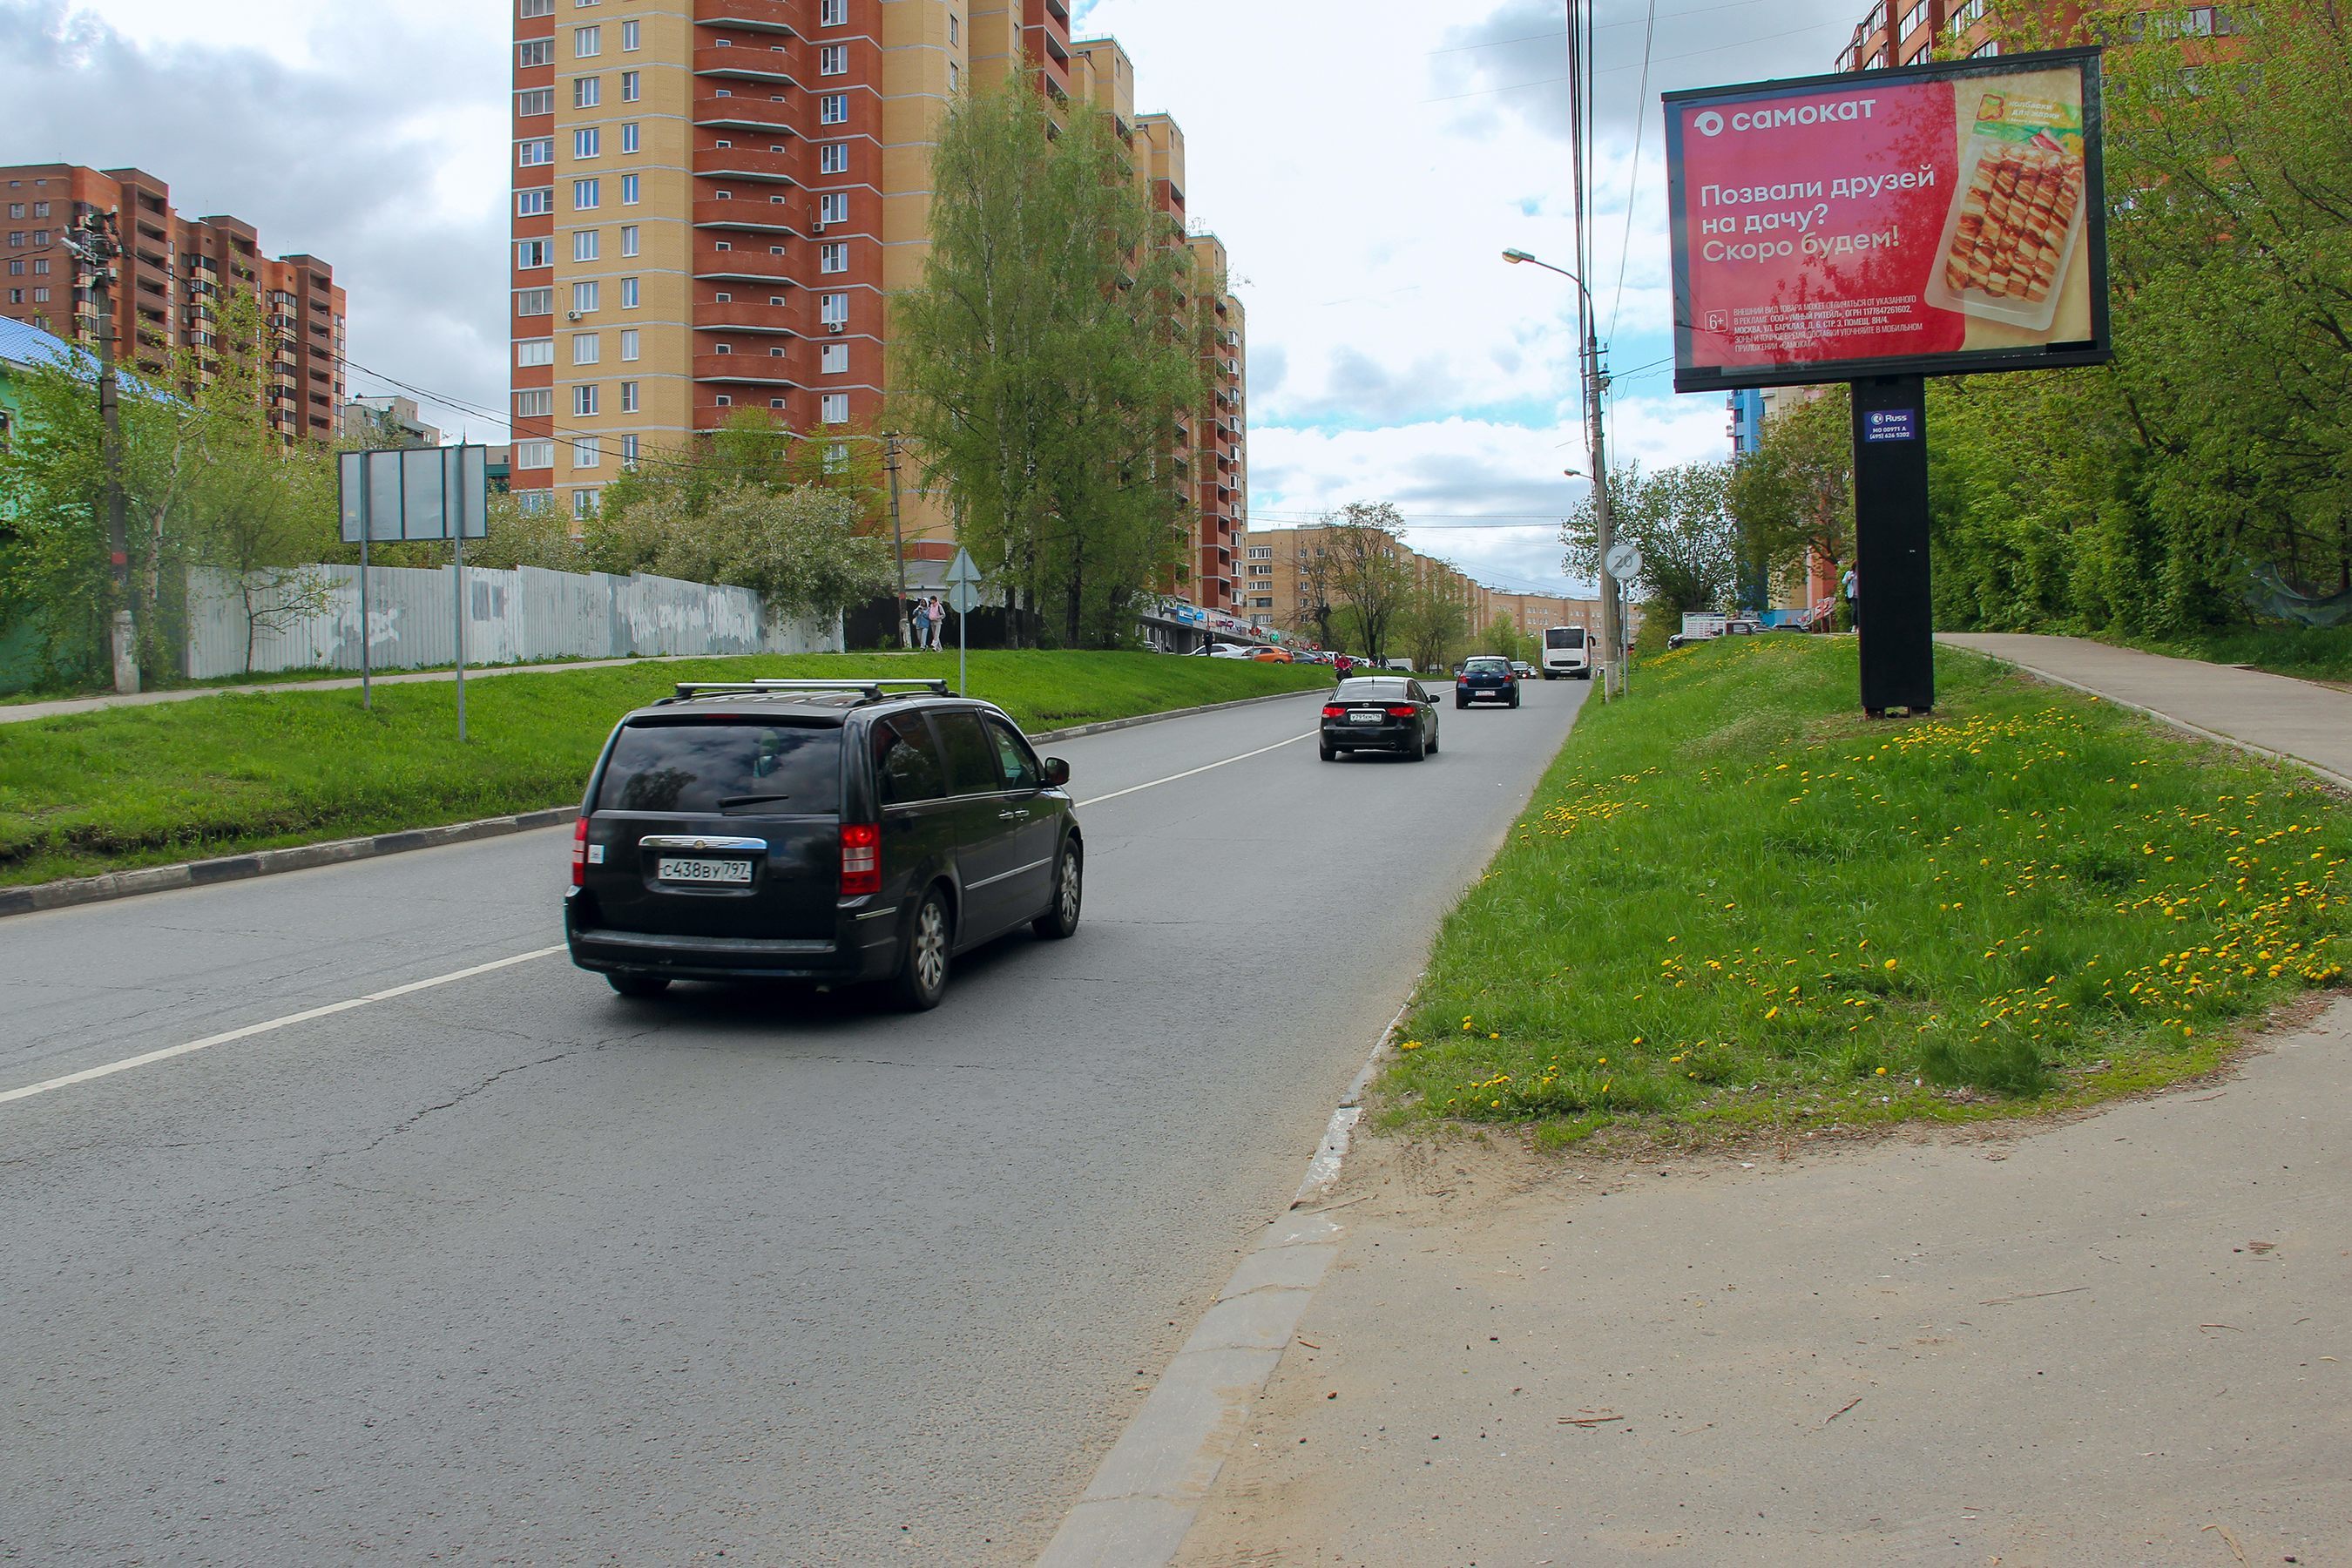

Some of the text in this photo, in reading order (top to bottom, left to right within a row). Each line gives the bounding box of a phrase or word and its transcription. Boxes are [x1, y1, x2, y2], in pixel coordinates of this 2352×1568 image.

[1732, 99, 1876, 131] самокат
[1701, 164, 1935, 206] Позвали друзей
[1702, 203, 1828, 234] на дачу?
[1702, 225, 1899, 263] Скоро будем!
[1734, 295, 1916, 316] ВНЕШНИЙ ВИД ТОВАРА МОЖЕТ ОТЛИЧАТЬСЯ ОТ УКАЗАННОГО
[1845, 308, 1862, 317] ОГРН
[1709, 314, 1724, 329] 6+
[1734, 322, 1923, 344] ЗОНЫ И ТОЧНОЕ ВРЕМЯ ДОСТАВКИ УТОЧНЯЙТЕ В МОБИЛЬНОМ
[1734, 341, 1778, 352] ПРИЛОЖЕНИИ
[1615, 555, 1632, 568] 20
[723, 862, 747, 875] 797
